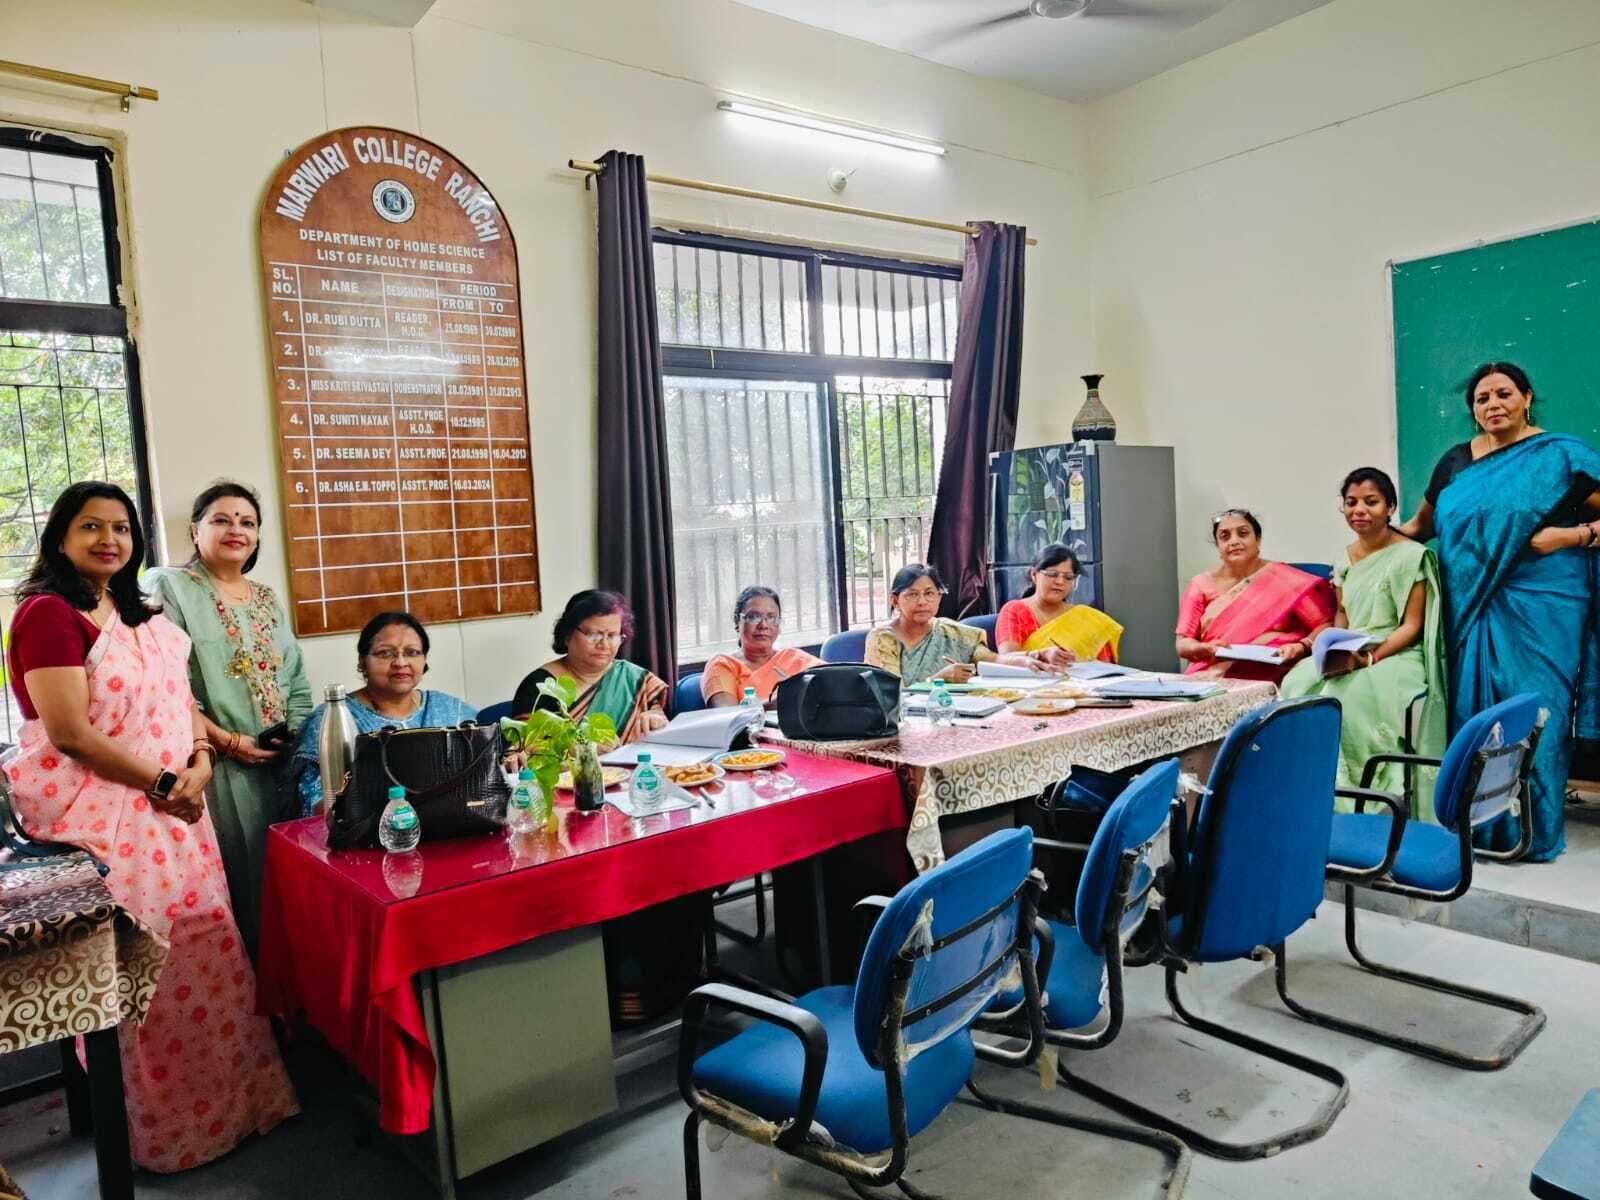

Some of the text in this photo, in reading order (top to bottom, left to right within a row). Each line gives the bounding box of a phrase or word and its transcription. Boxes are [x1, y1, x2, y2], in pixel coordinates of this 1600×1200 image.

[276, 142, 350, 222] MARWARI
[352, 136, 443, 182] COLLEGE
[444, 171, 501, 243] RANCHI
[300, 228, 485, 259] DEPARTMENT OF HOME SCIENCE
[317, 248, 473, 274] LIST OF FACULTY MEMBERS
[272, 267, 294, 281] SL.
[272, 281, 296, 295] NO.
[320, 279, 359, 293] NAME
[386, 284, 437, 298] DESIGNATION
[460, 283, 497, 297] PERIOD
[442, 298, 474, 311] FROM
[489, 301, 504, 313] TO
[282, 310, 294, 323] 1.
[305, 312, 381, 328] DR. RUBI DUTTA
[283, 343, 298, 356] 2.
[287, 378, 300, 390] 3.
[311, 380, 329, 392] MISS
[289, 413, 304, 425] 4.
[313, 414, 390, 426] DR. SUNITI NAYAK
[292, 447, 306, 459] 5.
[316, 448, 392, 459] DR. SEEMA DEY
[295, 481, 309, 493] 6.
[319, 481, 333, 492] DR.
[333, 480, 355, 492] ASHA
[371, 480, 396, 492] TOPPO
